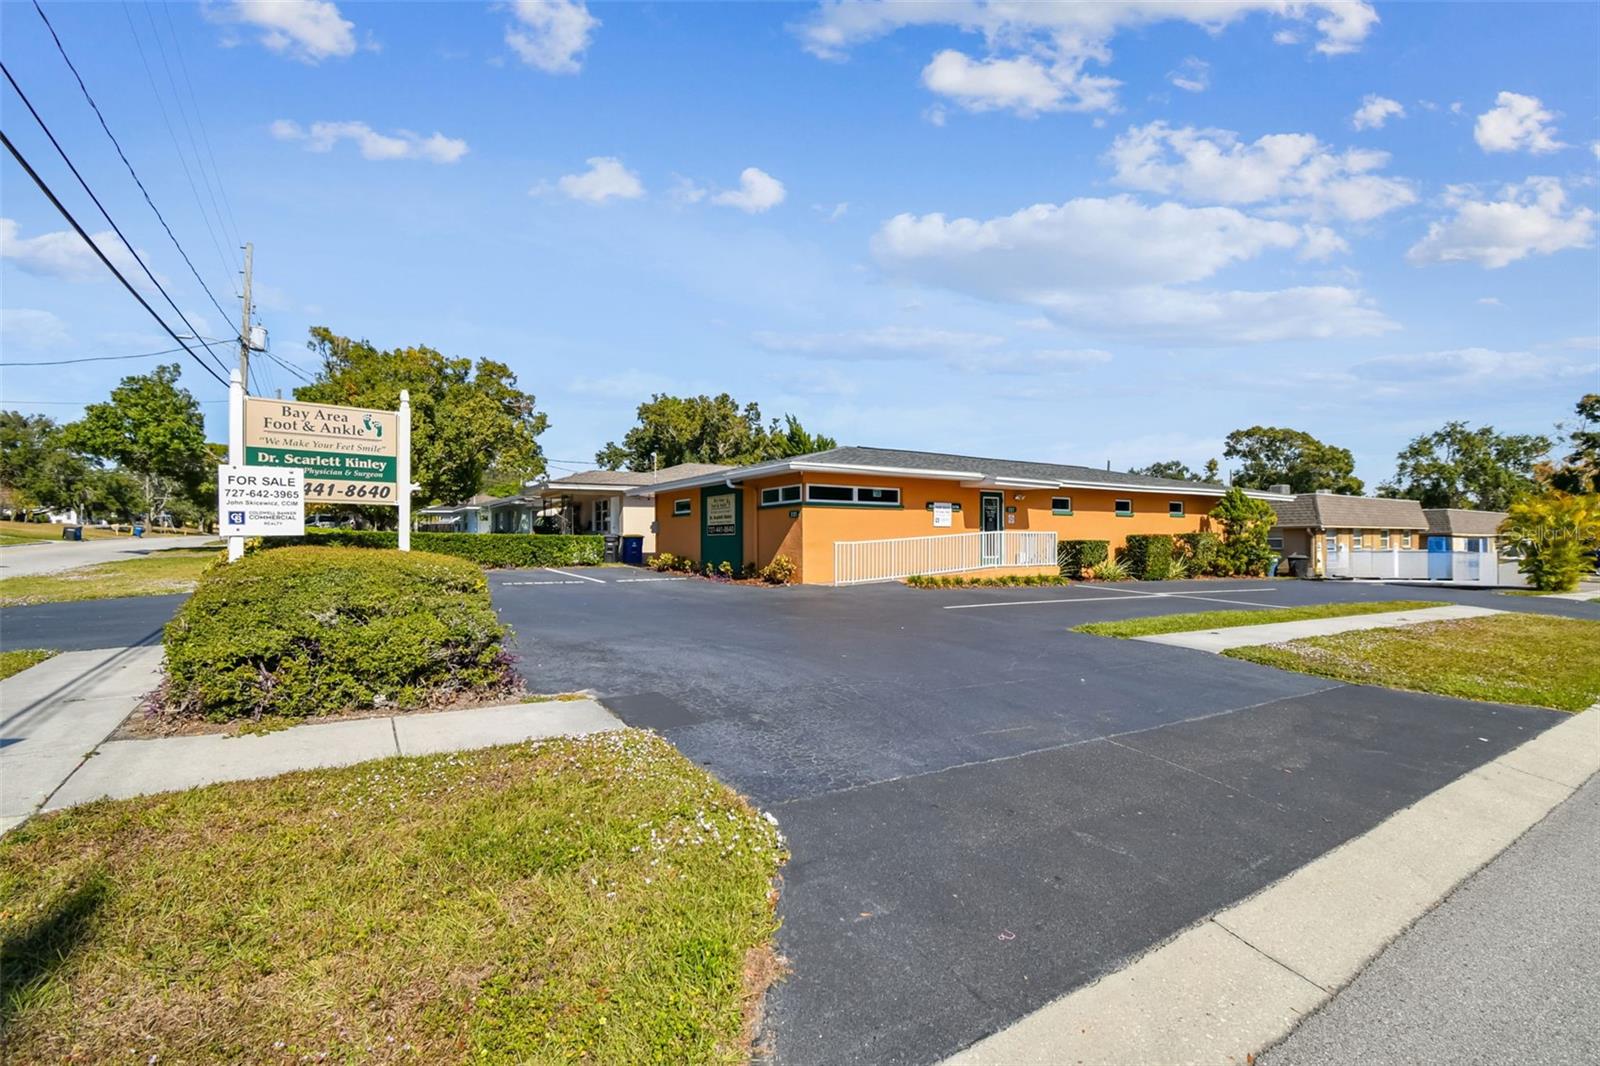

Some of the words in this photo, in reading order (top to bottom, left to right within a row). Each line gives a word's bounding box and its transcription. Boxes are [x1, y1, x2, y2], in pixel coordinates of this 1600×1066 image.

[282, 405, 310, 422] Bay
[314, 409, 348, 422] Area
[264, 417, 297, 431] Foot
[302, 421, 315, 432] &
[320, 422, 364, 437] Ankle
[282, 438, 310, 448] Make
[312, 440, 334, 449] Your
[336, 442, 354, 451] Feet
[257, 452, 279, 463] Dr.
[284, 453, 341, 467] Scarlett
[345, 458, 387, 472] Kinley
[304, 467, 342, 477] Physician
[353, 470, 383, 479] Surgeon
[228, 475, 257, 486] FOR
[262, 476, 296, 487] SALE
[224, 488, 300, 499] 727-642-3965
